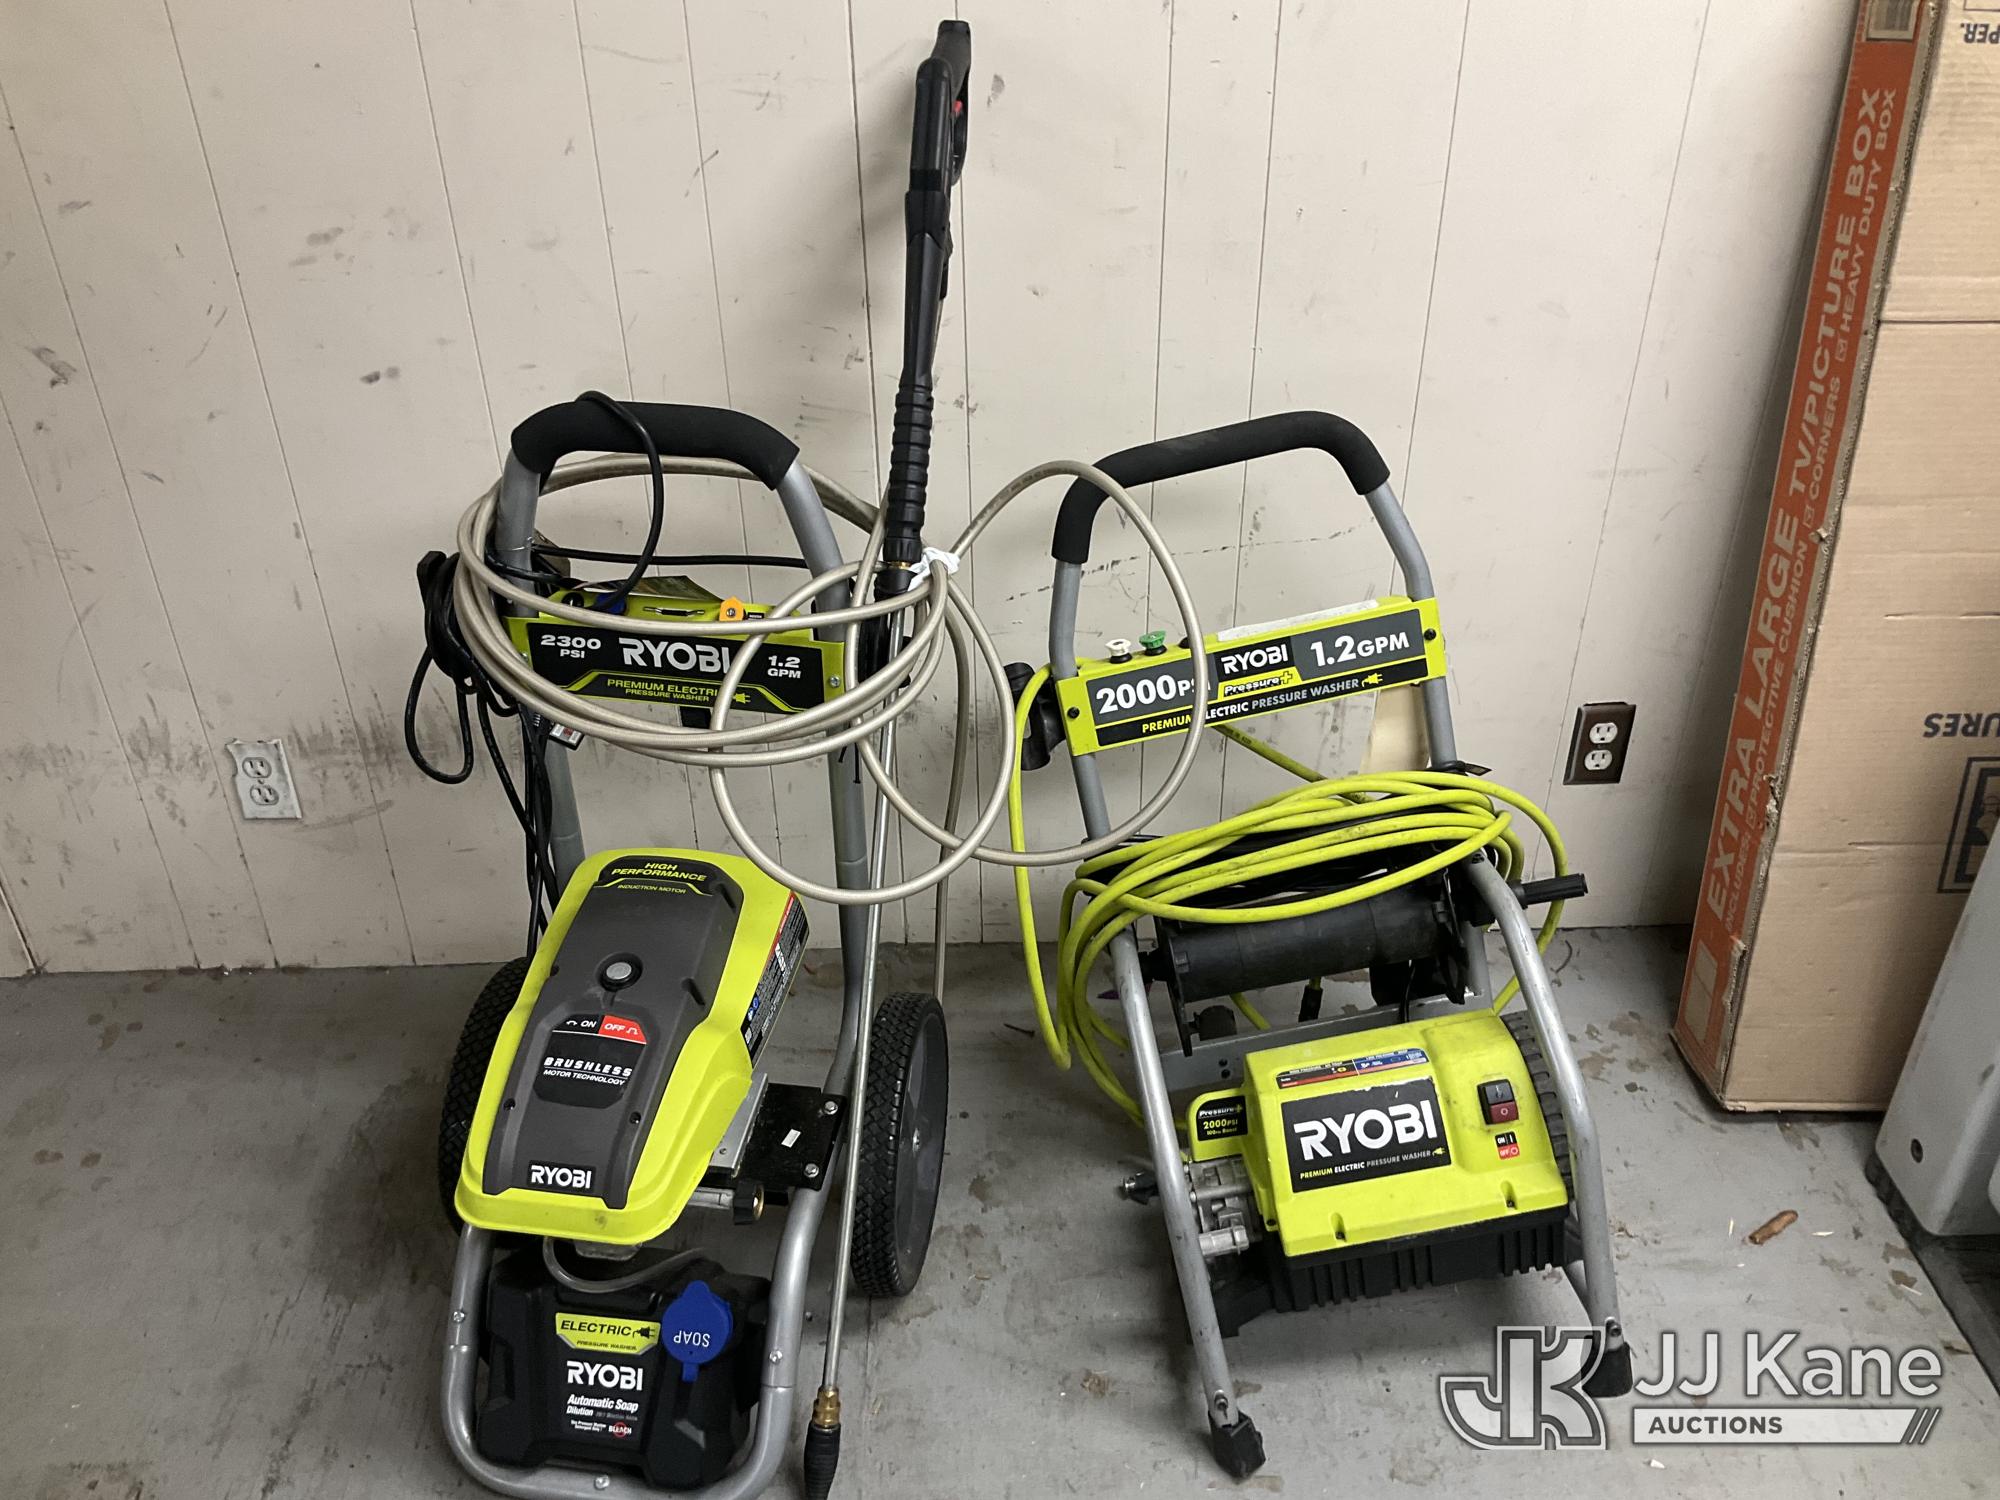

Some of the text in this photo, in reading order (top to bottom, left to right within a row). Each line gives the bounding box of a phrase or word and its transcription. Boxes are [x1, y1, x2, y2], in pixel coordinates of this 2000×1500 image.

[1748, 658, 1784, 806] PROTECTIVE
[1778, 539, 1808, 653] CUSHION
[1809, 376, 1840, 500] CORNERS
[1840, 243, 1865, 332] HEAVY
[1858, 158, 1882, 236] DUTY
[1874, 88, 1897, 150] BOX
[1706, 88, 1880, 921] EXTRA LARGE TV/PICTURE BOX
[540, 634, 601, 650] 2300
[560, 648, 585, 659] PSI
[618, 637, 730, 673] RYOBI
[768, 655, 801, 669] 1.2
[1221, 644, 1288, 674] RYOBI
[767, 668, 801, 679] GPM
[607, 678, 719, 697] PREMIUM ELECTRI
[625, 689, 710, 701] PRESSURE WASHER
[1251, 690, 1307, 709] PRESSURE
[1310, 679, 1359, 697] WASHER
[611, 868, 708, 882] PERFORMANCE
[644, 862, 678, 871] HIGH
[580, 1020, 597, 1028] ON
[604, 1023, 626, 1032] OFF
[543, 1056, 633, 1077] BRUSHLESS
[543, 1069, 626, 1086] MOTOR TECHNOLOGY
[1293, 1099, 1437, 1160] RYOBI
[1300, 1150, 1431, 1180] PREMIUM ELECTRIC PRESSURE WASHER
[531, 1164, 592, 1189] RYOBI
[560, 1319, 632, 1336] ELECTRIC
[673, 1330, 711, 1347] SOAP
[566, 1360, 643, 1391] RYOBI
[566, 1405, 594, 1417] Dilution
[567, 1393, 639, 1414] Automatic Soap
